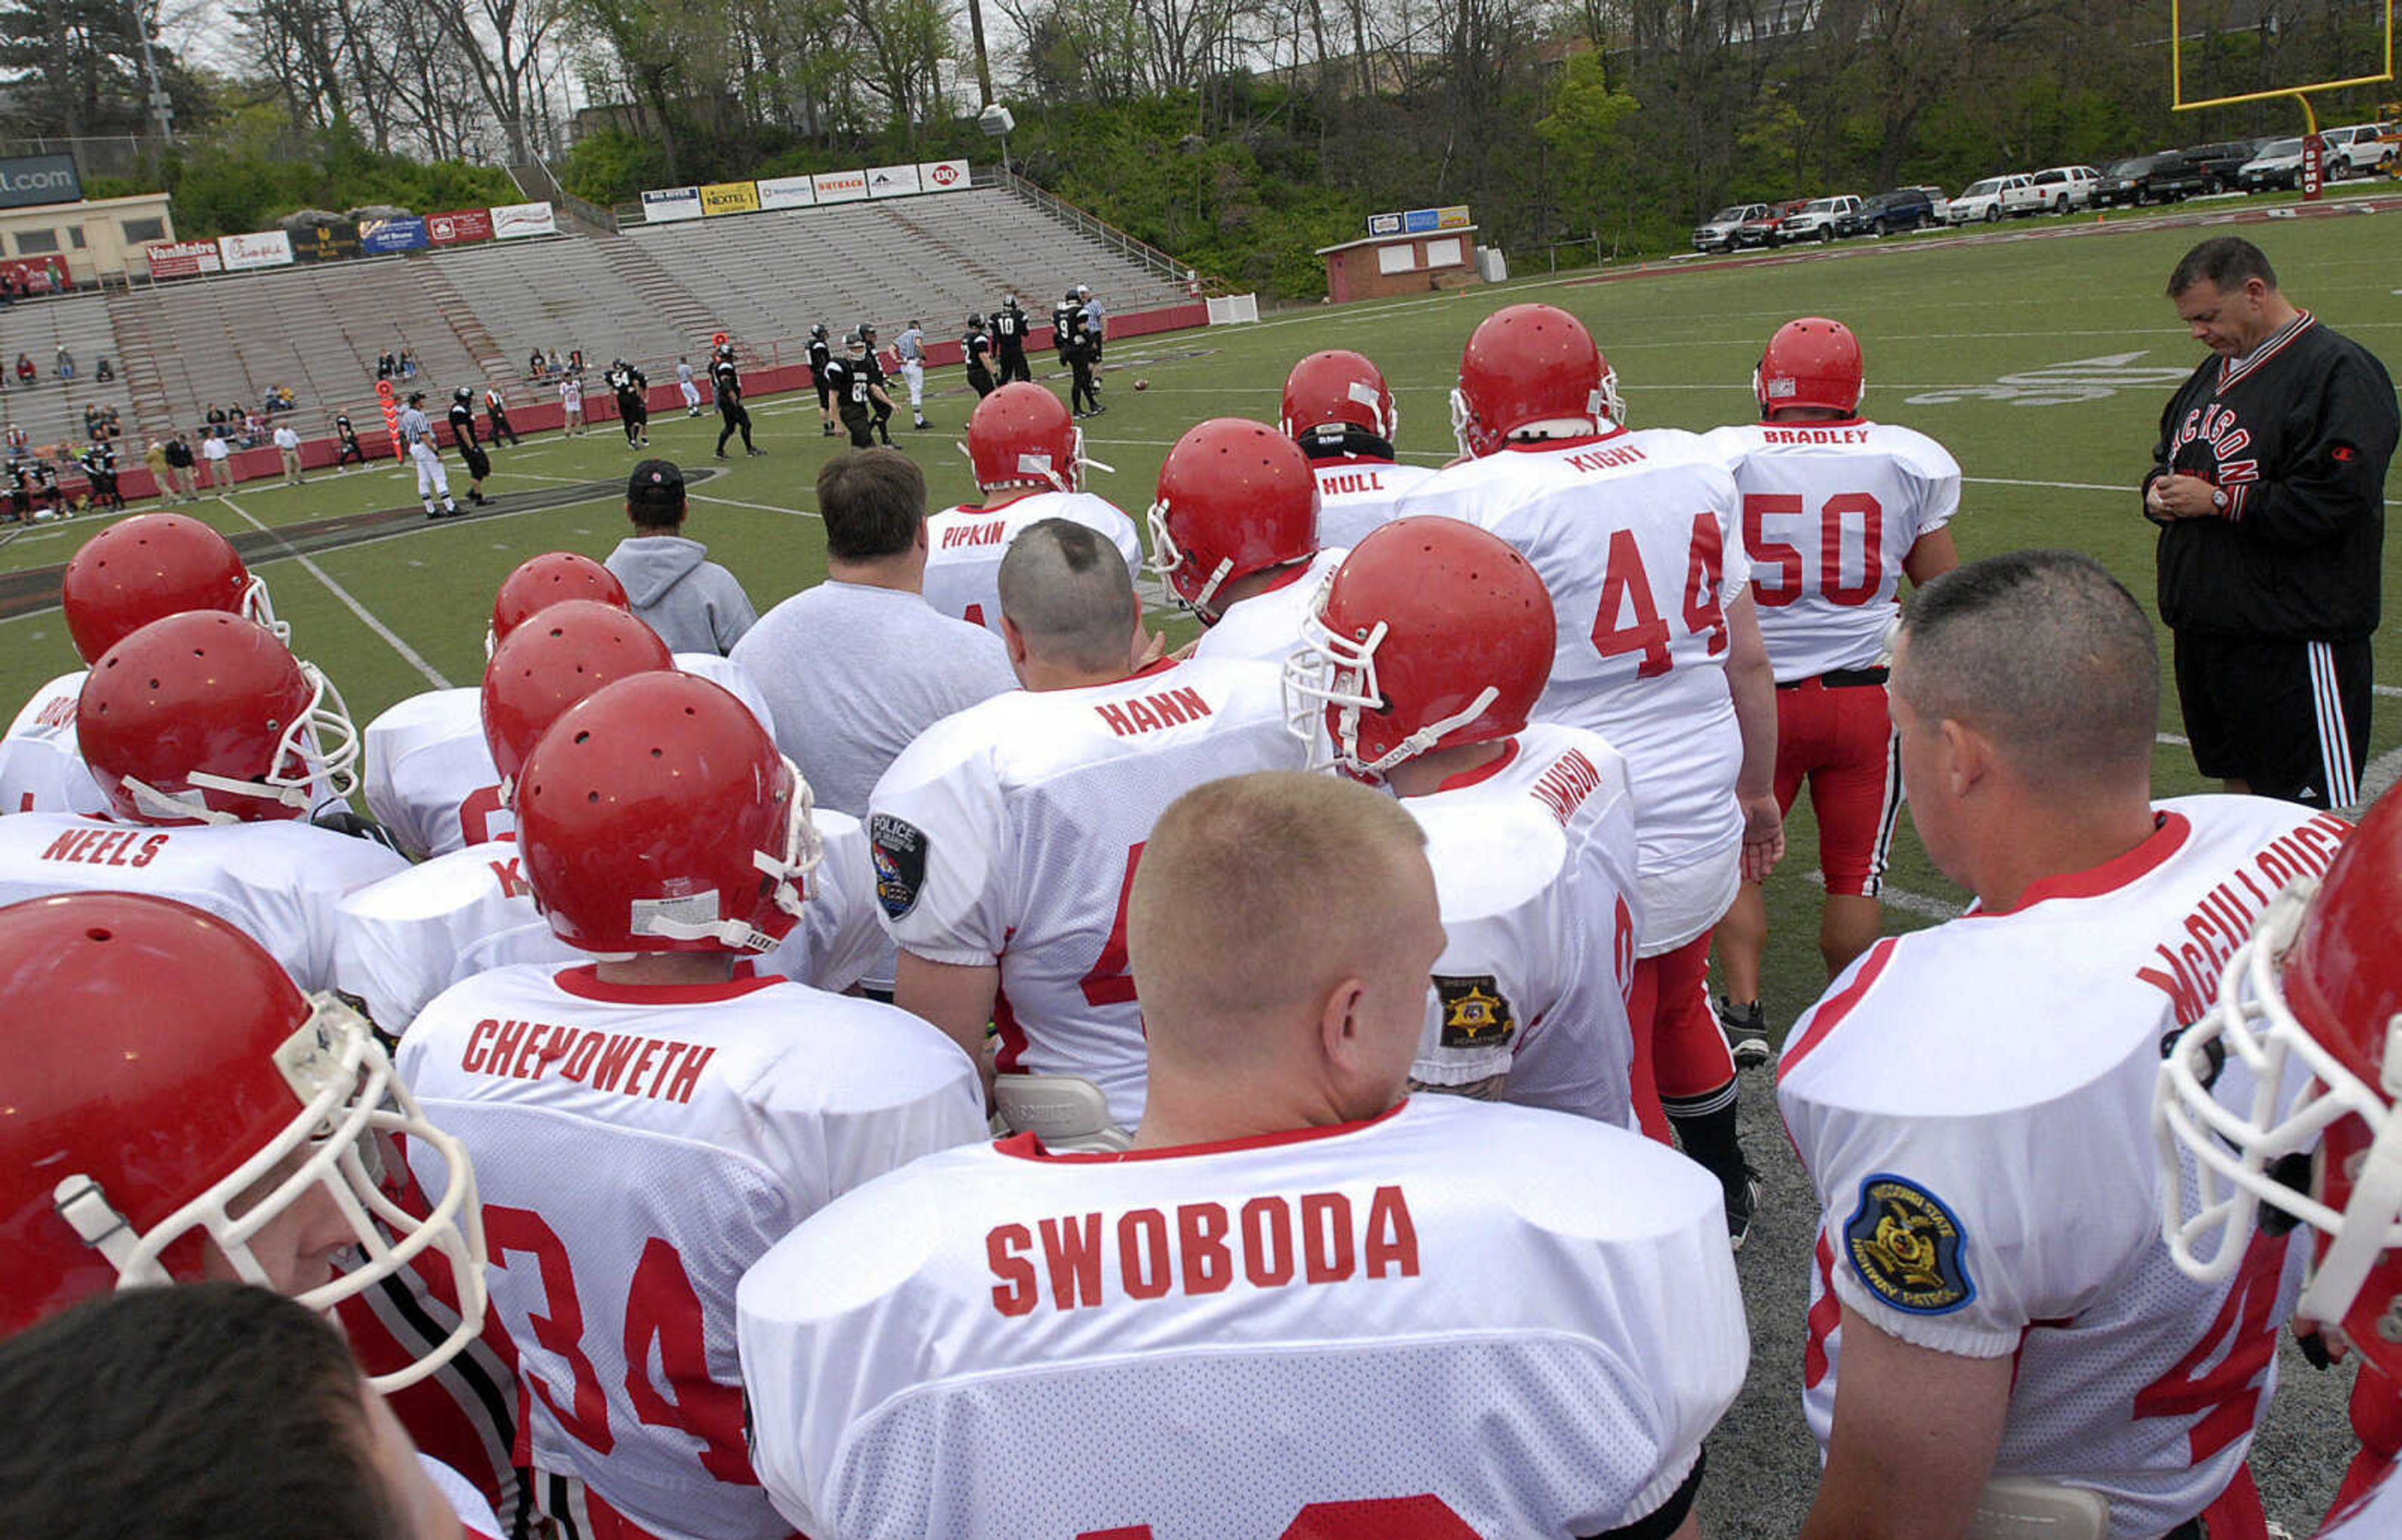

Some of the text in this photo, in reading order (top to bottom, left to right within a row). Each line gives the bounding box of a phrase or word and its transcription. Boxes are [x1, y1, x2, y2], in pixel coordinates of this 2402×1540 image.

[707, 194, 745, 206] NEXTEL
[998, 318, 1014, 335] 10
[1059, 320, 1068, 339] 9
[612, 371, 629, 387] 54
[1763, 430, 1869, 444] BRADLEY
[1564, 444, 1648, 473] KIGHT
[1322, 472, 1384, 495] HULL
[941, 521, 1006, 550] PIPKIN
[1743, 492, 1882, 607] 50
[1590, 511, 1728, 680] 44
[1093, 686, 1213, 736] HANN
[873, 816, 916, 843] POLICE
[41, 829, 170, 868] NEELS
[461, 1018, 717, 1105] CHENOWETH
[985, 1185, 1421, 1318] SWOBODA
[481, 1202, 764, 1486] 34
